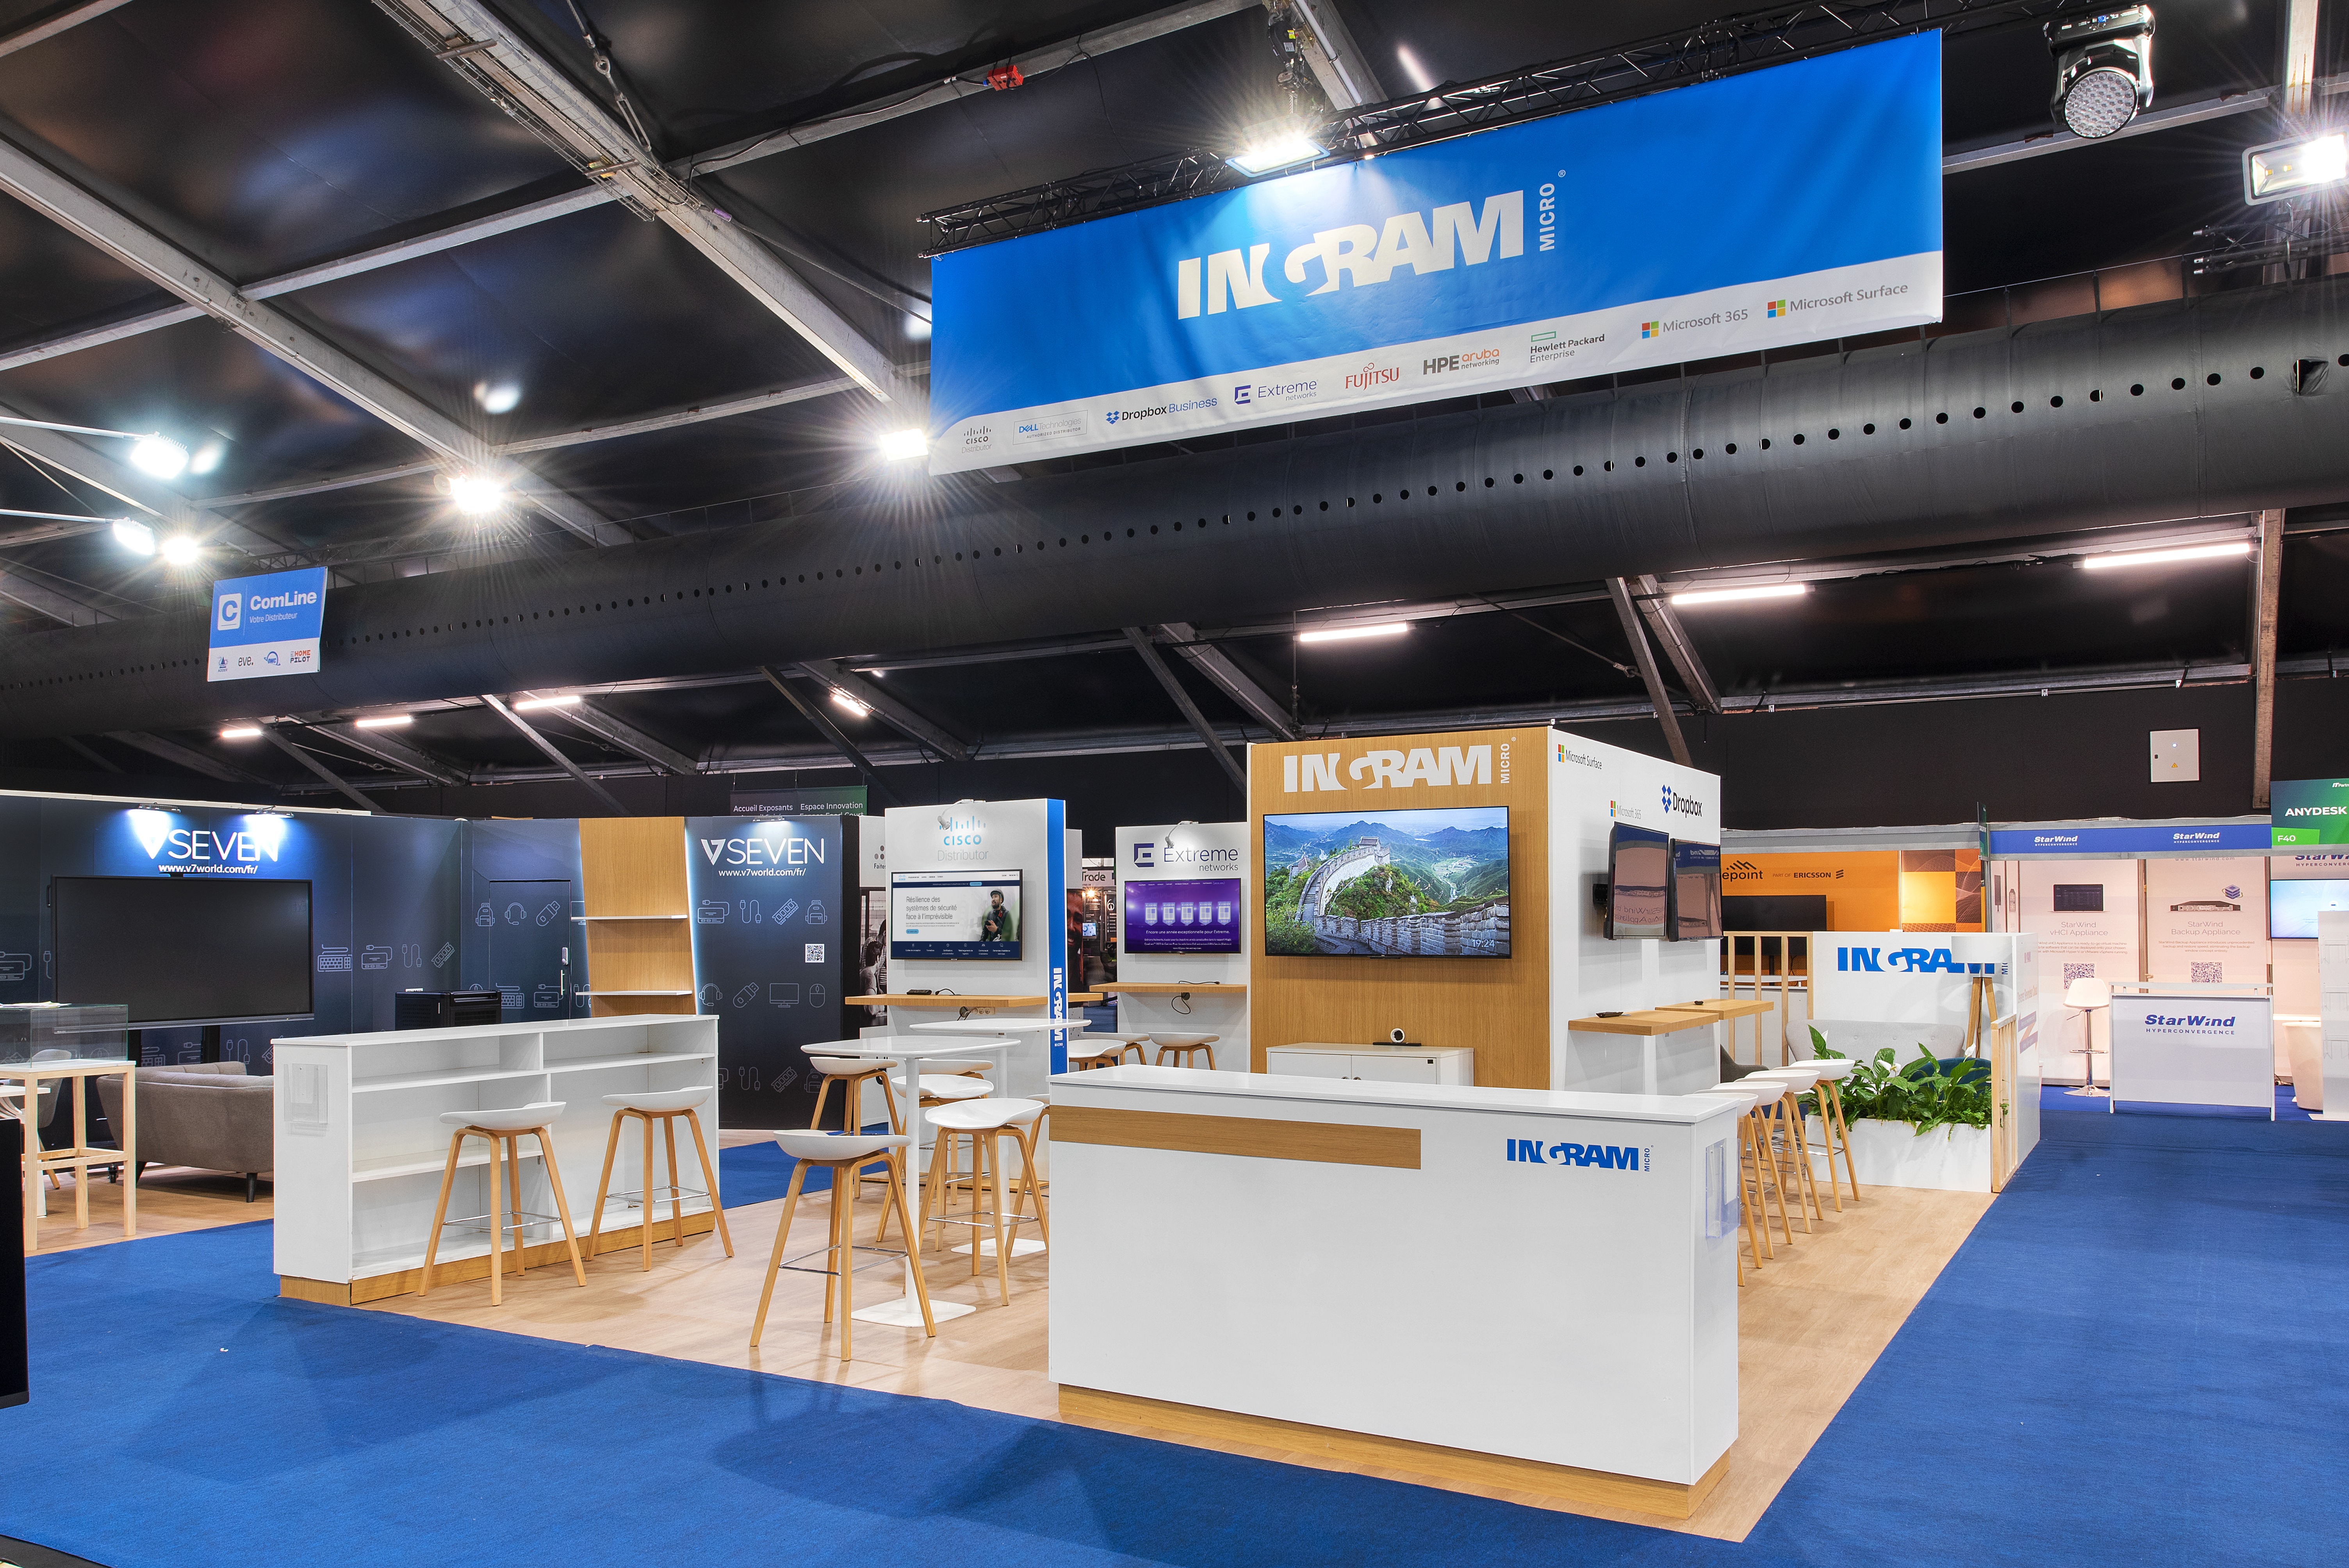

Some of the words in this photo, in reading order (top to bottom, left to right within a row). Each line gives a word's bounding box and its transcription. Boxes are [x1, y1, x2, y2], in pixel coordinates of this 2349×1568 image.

[1539, 183, 1555, 252] MICRO
[1178, 190, 1523, 320] INGRAM
[1790, 291, 1853, 312] Microsoft
[1857, 284, 1909, 300] Surface
[1663, 314, 1721, 332] Microsoft
[1725, 309, 1748, 322] 365
[1530, 342, 1567, 354] Hewlett
[1568, 334, 1605, 348] Packard
[1461, 348, 1500, 362] aruba
[1530, 350, 1575, 363] Enterprise
[1423, 355, 1460, 375] HPE
[1461, 358, 1500, 370] networking
[1345, 365, 1400, 390] FUJITSU
[1258, 380, 1317, 398] Extreme
[1285, 391, 1317, 401] networks
[1122, 405, 1167, 421] Dropbox
[1168, 397, 1218, 413] Business
[1019, 424, 1039, 433] DELL
[1039, 418, 1082, 430] Technologies
[1053, 427, 1081, 435] DISTRIBUTOR
[966, 436, 989, 445] CISCO
[962, 444, 992, 454] Distributor
[250, 591, 317, 610] ComLine
[250, 615, 264, 624] Votre
[265, 612, 298, 622] Distributeur
[1501, 743, 1510, 784] MICRO
[1566, 749, 1586, 766] Microsoft
[1586, 756, 1602, 770] Surface
[1284, 745, 1492, 793] INGRAM
[759, 804, 793, 813] Exposants
[800, 803, 824, 811] Espace
[826, 802, 863, 810] Innovation
[1617, 804, 1634, 818] Microsoft
[1673, 792, 1702, 818] Dropbox
[2285, 806, 2347, 816] ANYDESK
[943, 835, 982, 846] CISCO
[937, 850, 989, 861] Distributor
[1164, 846, 1238, 863] Extreme
[159, 864, 258, 874] www.v7world.com/fr/
[718, 868, 806, 877] www.v7world.com/fr/
[1199, 863, 1239, 871] networks
[1472, 939, 1495, 948] 19:24
[2145, 1014, 2236, 1027] StarWind
[1507, 1139, 1639, 1171] INGRAM
